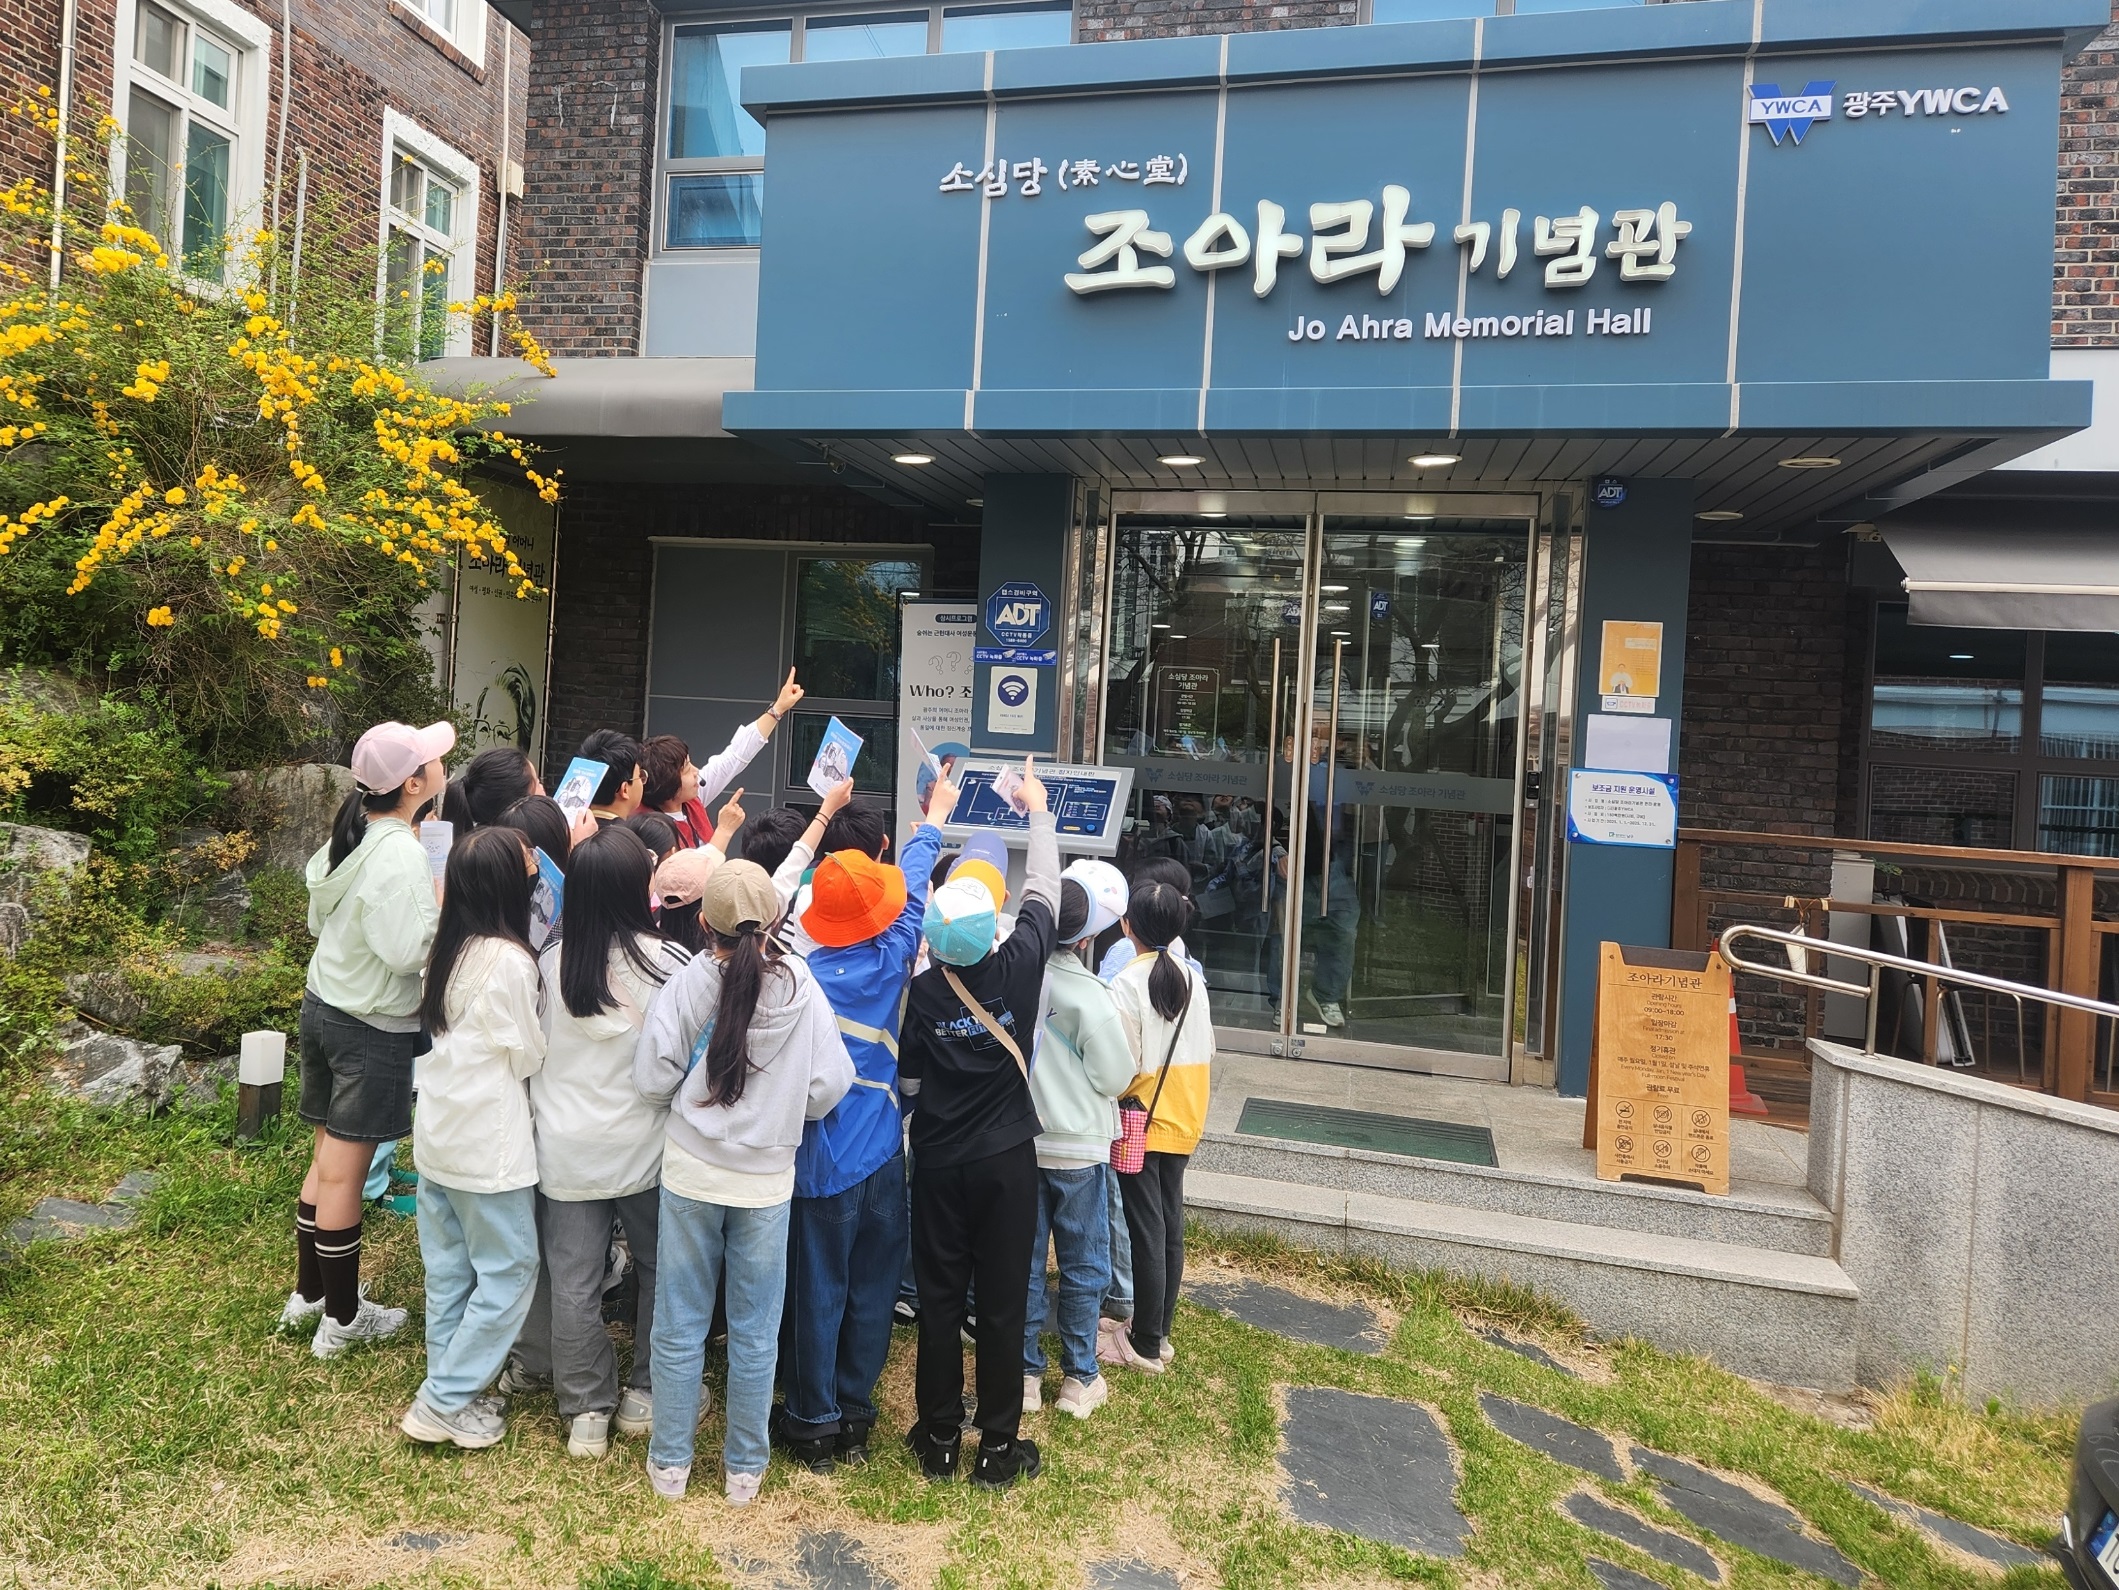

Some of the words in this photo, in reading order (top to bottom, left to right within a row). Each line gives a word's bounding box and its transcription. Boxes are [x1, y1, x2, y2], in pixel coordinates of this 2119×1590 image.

[1760, 99, 1823, 115] YWCA
[939, 157, 1048, 198] 소심당
[1064, 184, 1436, 297] 조아라
[1454, 201, 1693, 289] 기념관
[1288, 316, 1326, 341] Jo
[1336, 314, 1413, 340] Ahra
[1425, 309, 1574, 339] Memorial
[1587, 307, 1651, 335] Hall
[1598, 486, 1623, 498] ADT
[1373, 600, 1389, 611] ADT
[995, 602, 1042, 627] ADT
[1189, 673, 1209, 682] 조아라
[909, 684, 955, 698] Who?
[1178, 682, 1198, 690] 기념관
[1592, 783, 1612, 793] 보조금
[1613, 785, 1627, 794] 지원
[1628, 786, 1656, 795] 운영시설
[1627, 972, 1703, 989] 조아라기념관
[1651, 993, 1678, 1002] 관람시간
[1650, 1019, 1677, 1029] 입장마감
[1650, 1045, 1676, 1055] 정기휴관
[1646, 1083, 1666, 1092] 관람료
[1667, 1085, 1680, 1094] 무료
